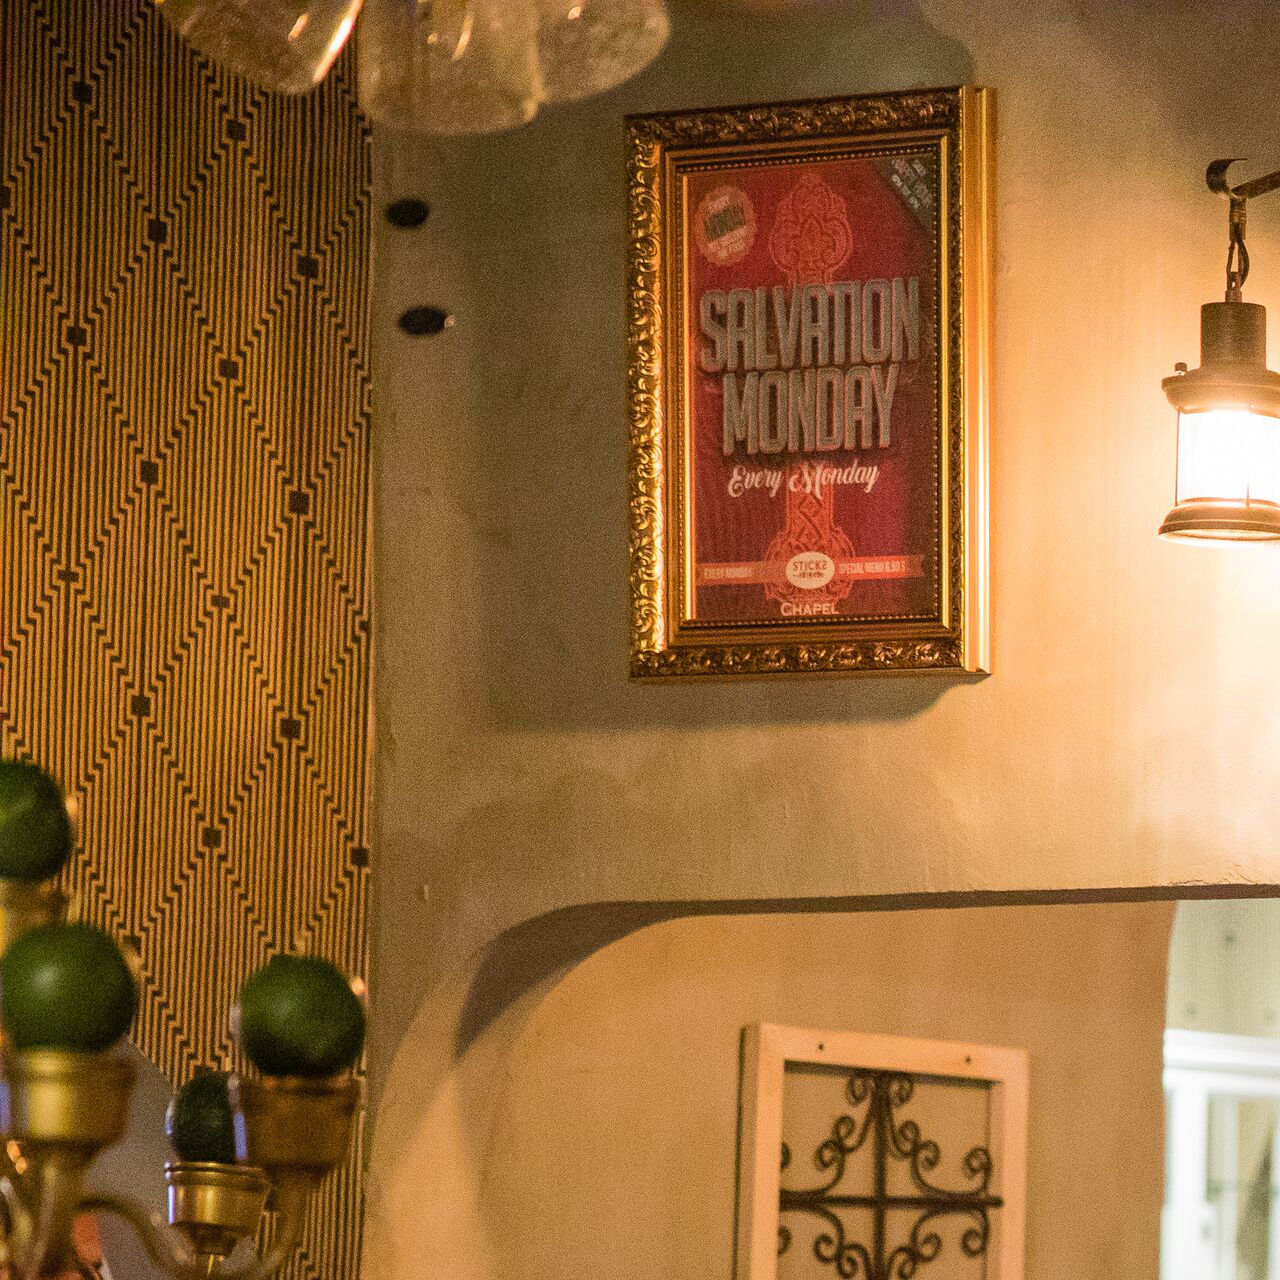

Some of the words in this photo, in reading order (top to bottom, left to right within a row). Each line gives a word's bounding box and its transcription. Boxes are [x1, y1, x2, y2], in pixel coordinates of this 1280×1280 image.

[700, 277, 920, 373] SALVATION
[722, 364, 899, 456] MONDAY
[727, 465, 782, 498] Every
[788, 458, 881, 500] Monday
[780, 602, 840, 617] CHAPEL
